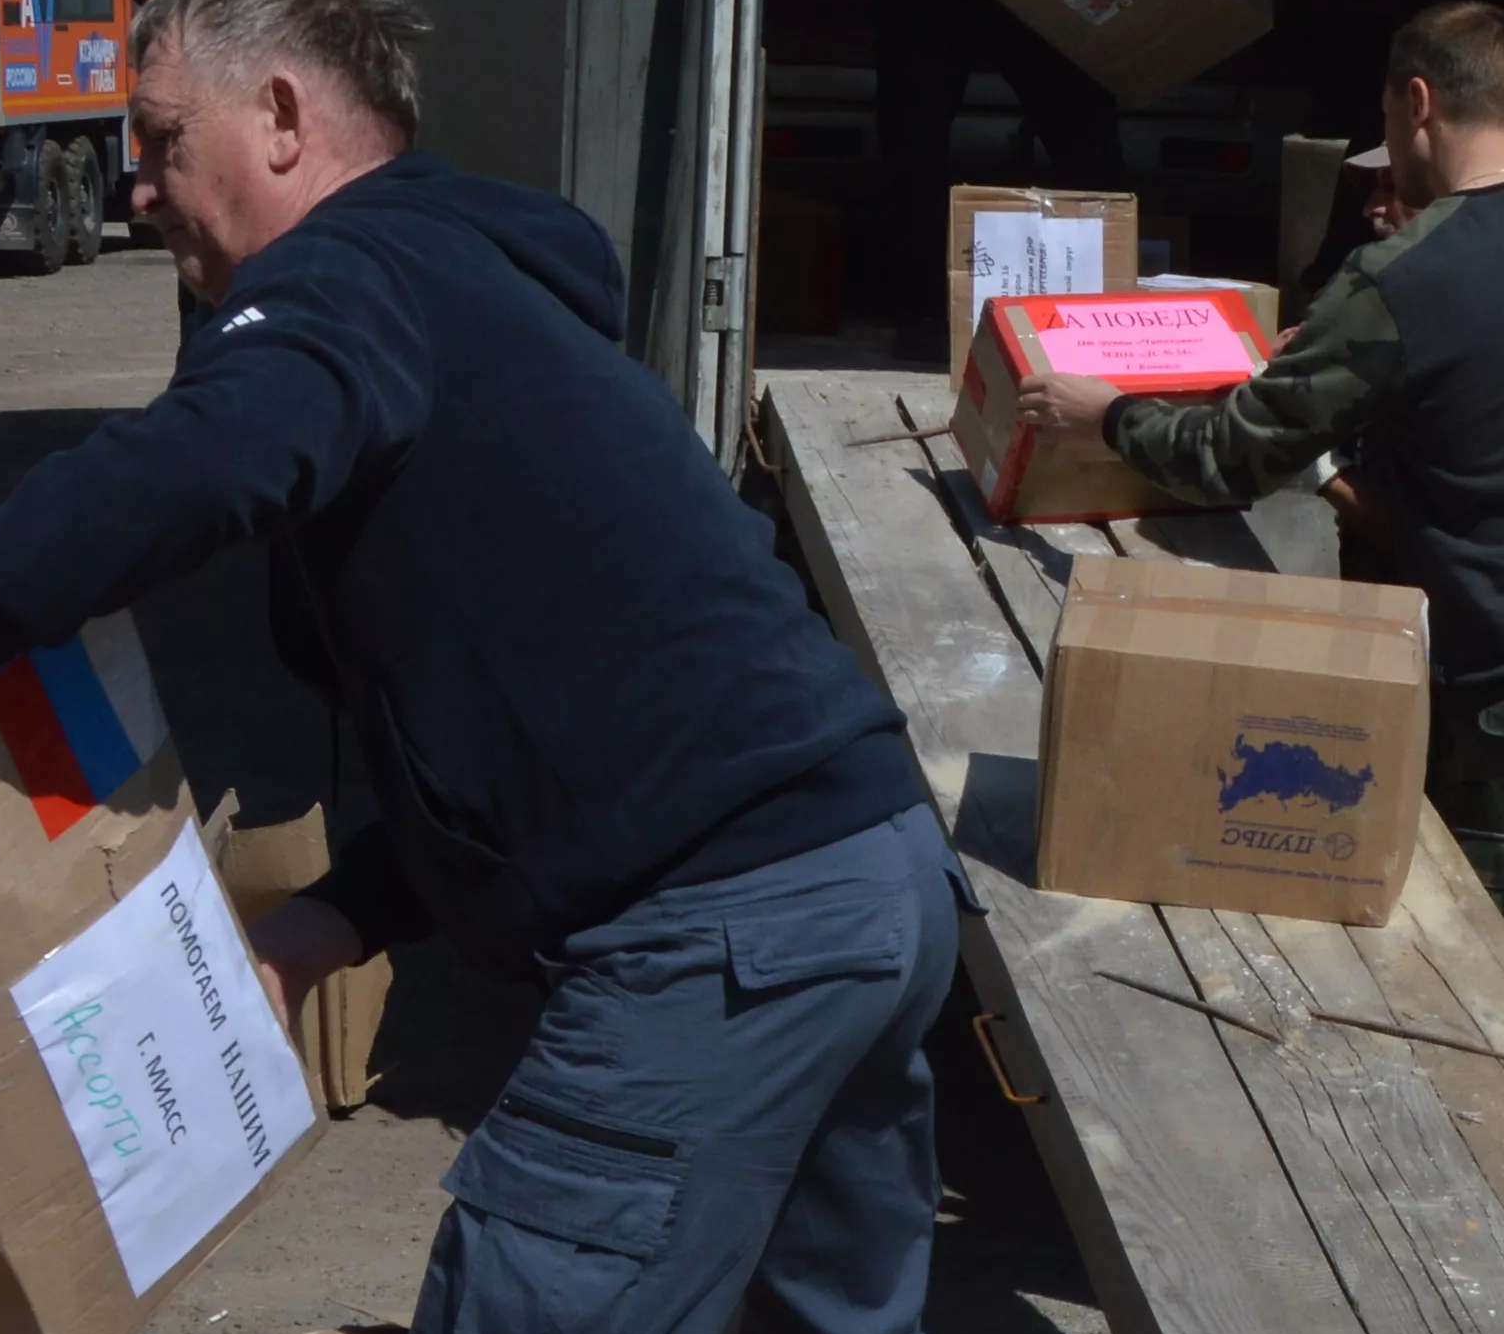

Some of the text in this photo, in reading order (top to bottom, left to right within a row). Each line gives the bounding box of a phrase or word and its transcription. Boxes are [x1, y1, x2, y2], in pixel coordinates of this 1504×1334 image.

[1091, 307, 1212, 330] ПОБЕДУ
[1220, 827, 1317, 855] ПУЛЬС
[160, 881, 272, 1169] ПОМОГАЕМ НАШИМ
[54, 999, 143, 1159] АССОРТИ
[145, 1054, 188, 1146] МИАСС
